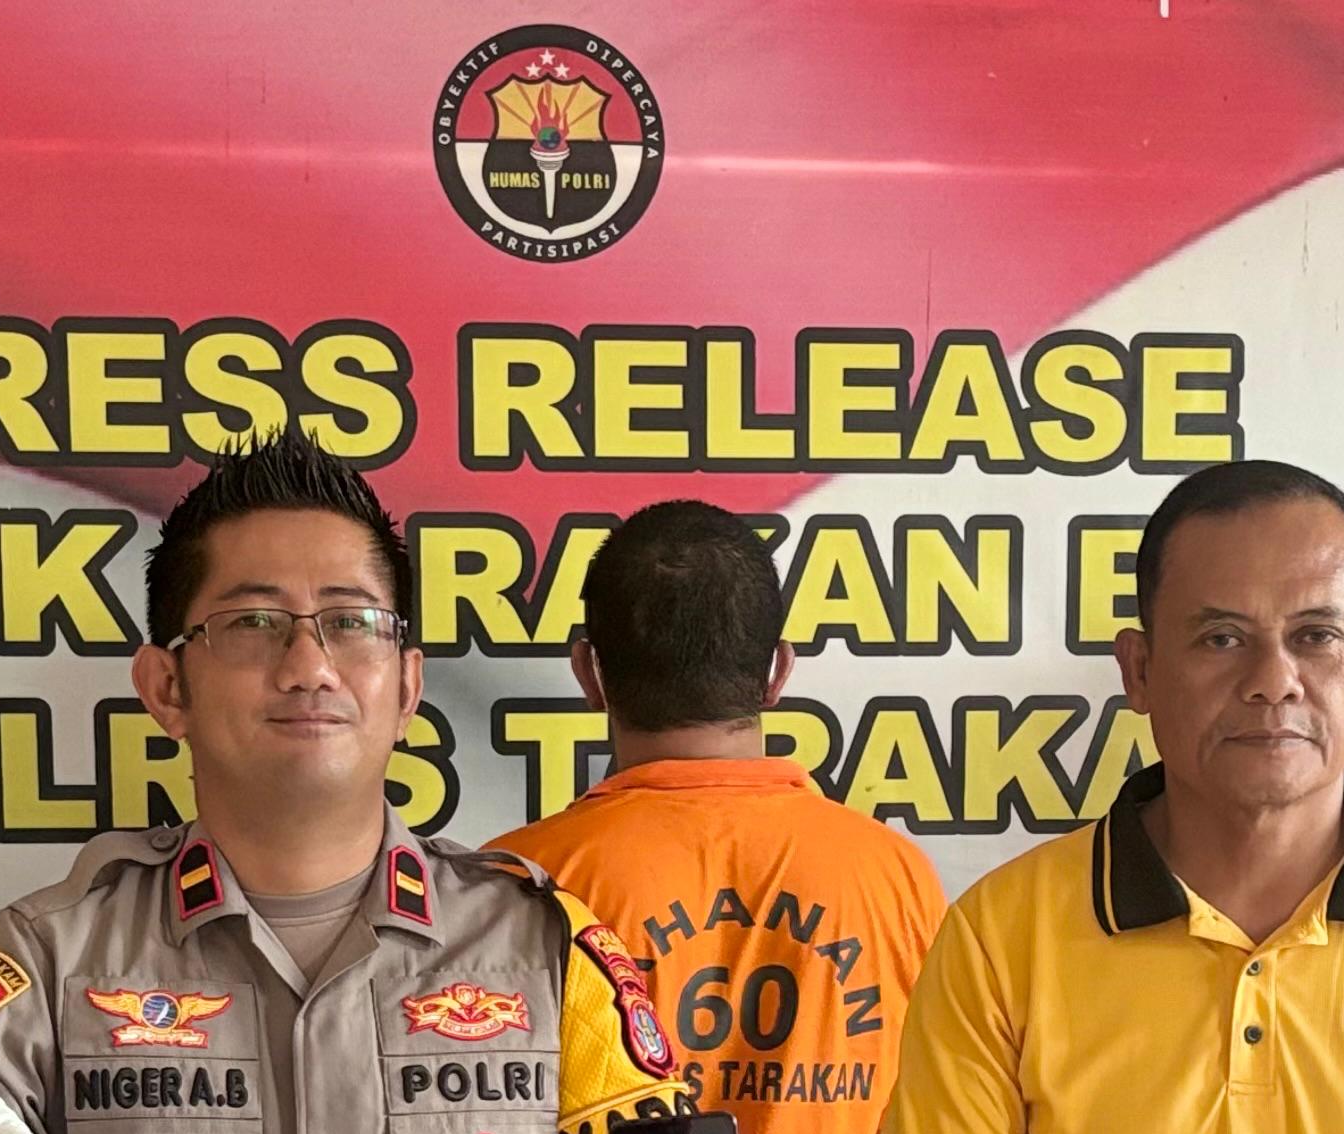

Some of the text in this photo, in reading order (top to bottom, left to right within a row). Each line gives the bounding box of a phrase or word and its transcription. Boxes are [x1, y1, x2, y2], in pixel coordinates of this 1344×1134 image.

[437, 42, 501, 145] OBYEKTIF
[586, 40, 660, 159] DIPERCAYA
[488, 171, 611, 189] HUMAS POLRI
[481, 221, 620, 258] PARTISIPASI
[464, 330, 1241, 468] RELEASE
[641, 887, 884, 1038] HANAN
[676, 964, 799, 1052] 60
[74, 1066, 249, 1110] NIGER A.B
[401, 1061, 545, 1103] POLRI
[719, 1060, 876, 1103] TARAKAN
